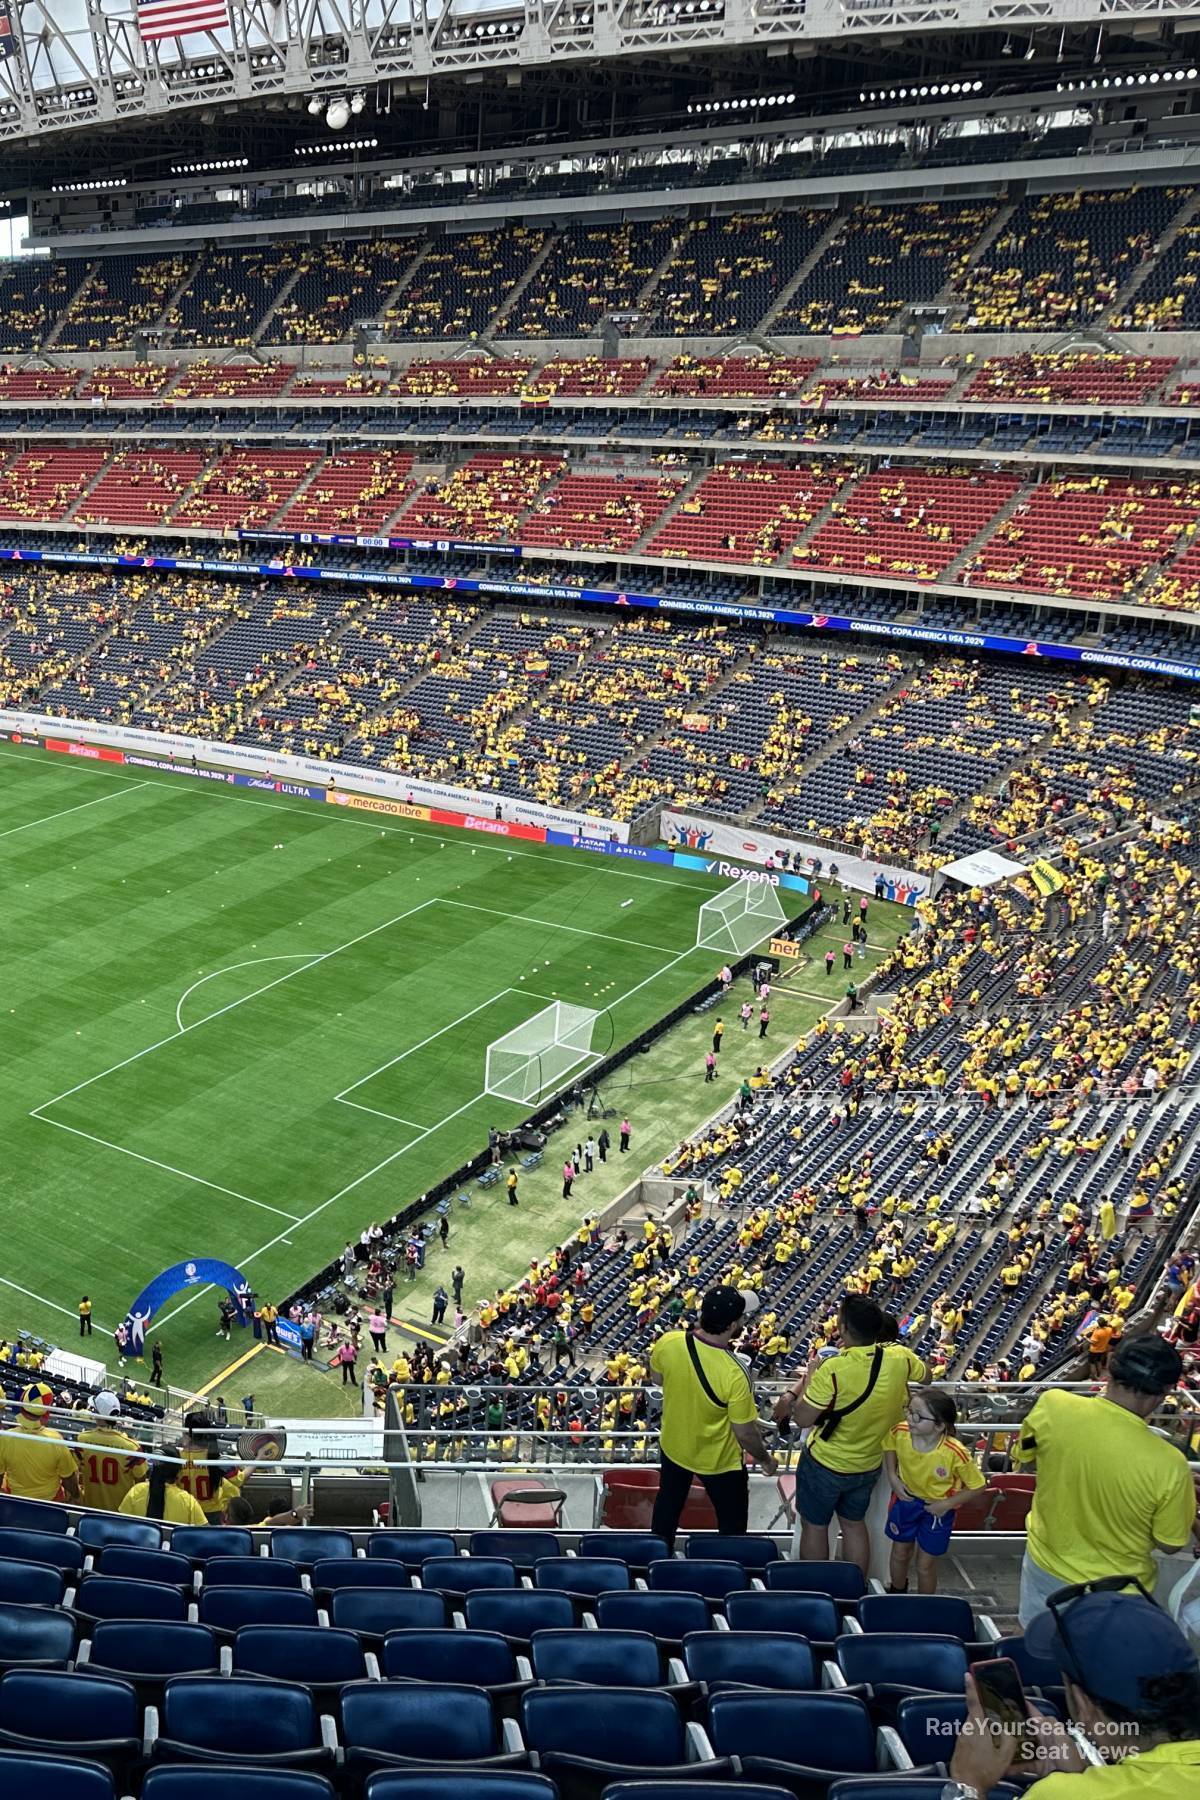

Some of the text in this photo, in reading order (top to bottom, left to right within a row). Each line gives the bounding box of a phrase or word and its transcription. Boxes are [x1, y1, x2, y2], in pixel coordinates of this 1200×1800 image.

[850, 621, 891, 635] CONMEBOL
[891, 626, 913, 638] COPA
[912, 628, 947, 642] AMERICA
[948, 633, 964, 644] USA
[1080, 651, 1194, 677] CONMEBOL COPA AMERICA
[69, 744, 100, 759] Betano
[281, 783, 311, 797] ULTRA
[353, 797, 422, 817] mercado libre
[464, 815, 510, 835] Betano
[515, 806, 545, 818] CONMEBOL
[546, 812, 560, 821] COPA
[559, 816, 586, 827] AMERICA
[587, 821, 598, 830] USA
[580, 838, 606, 848] LATAM
[623, 847, 647, 857] DELTA
[717, 861, 780, 886] Rexona
[87, 1455, 119, 1485] 10
[180, 1475, 214, 1501] 10
